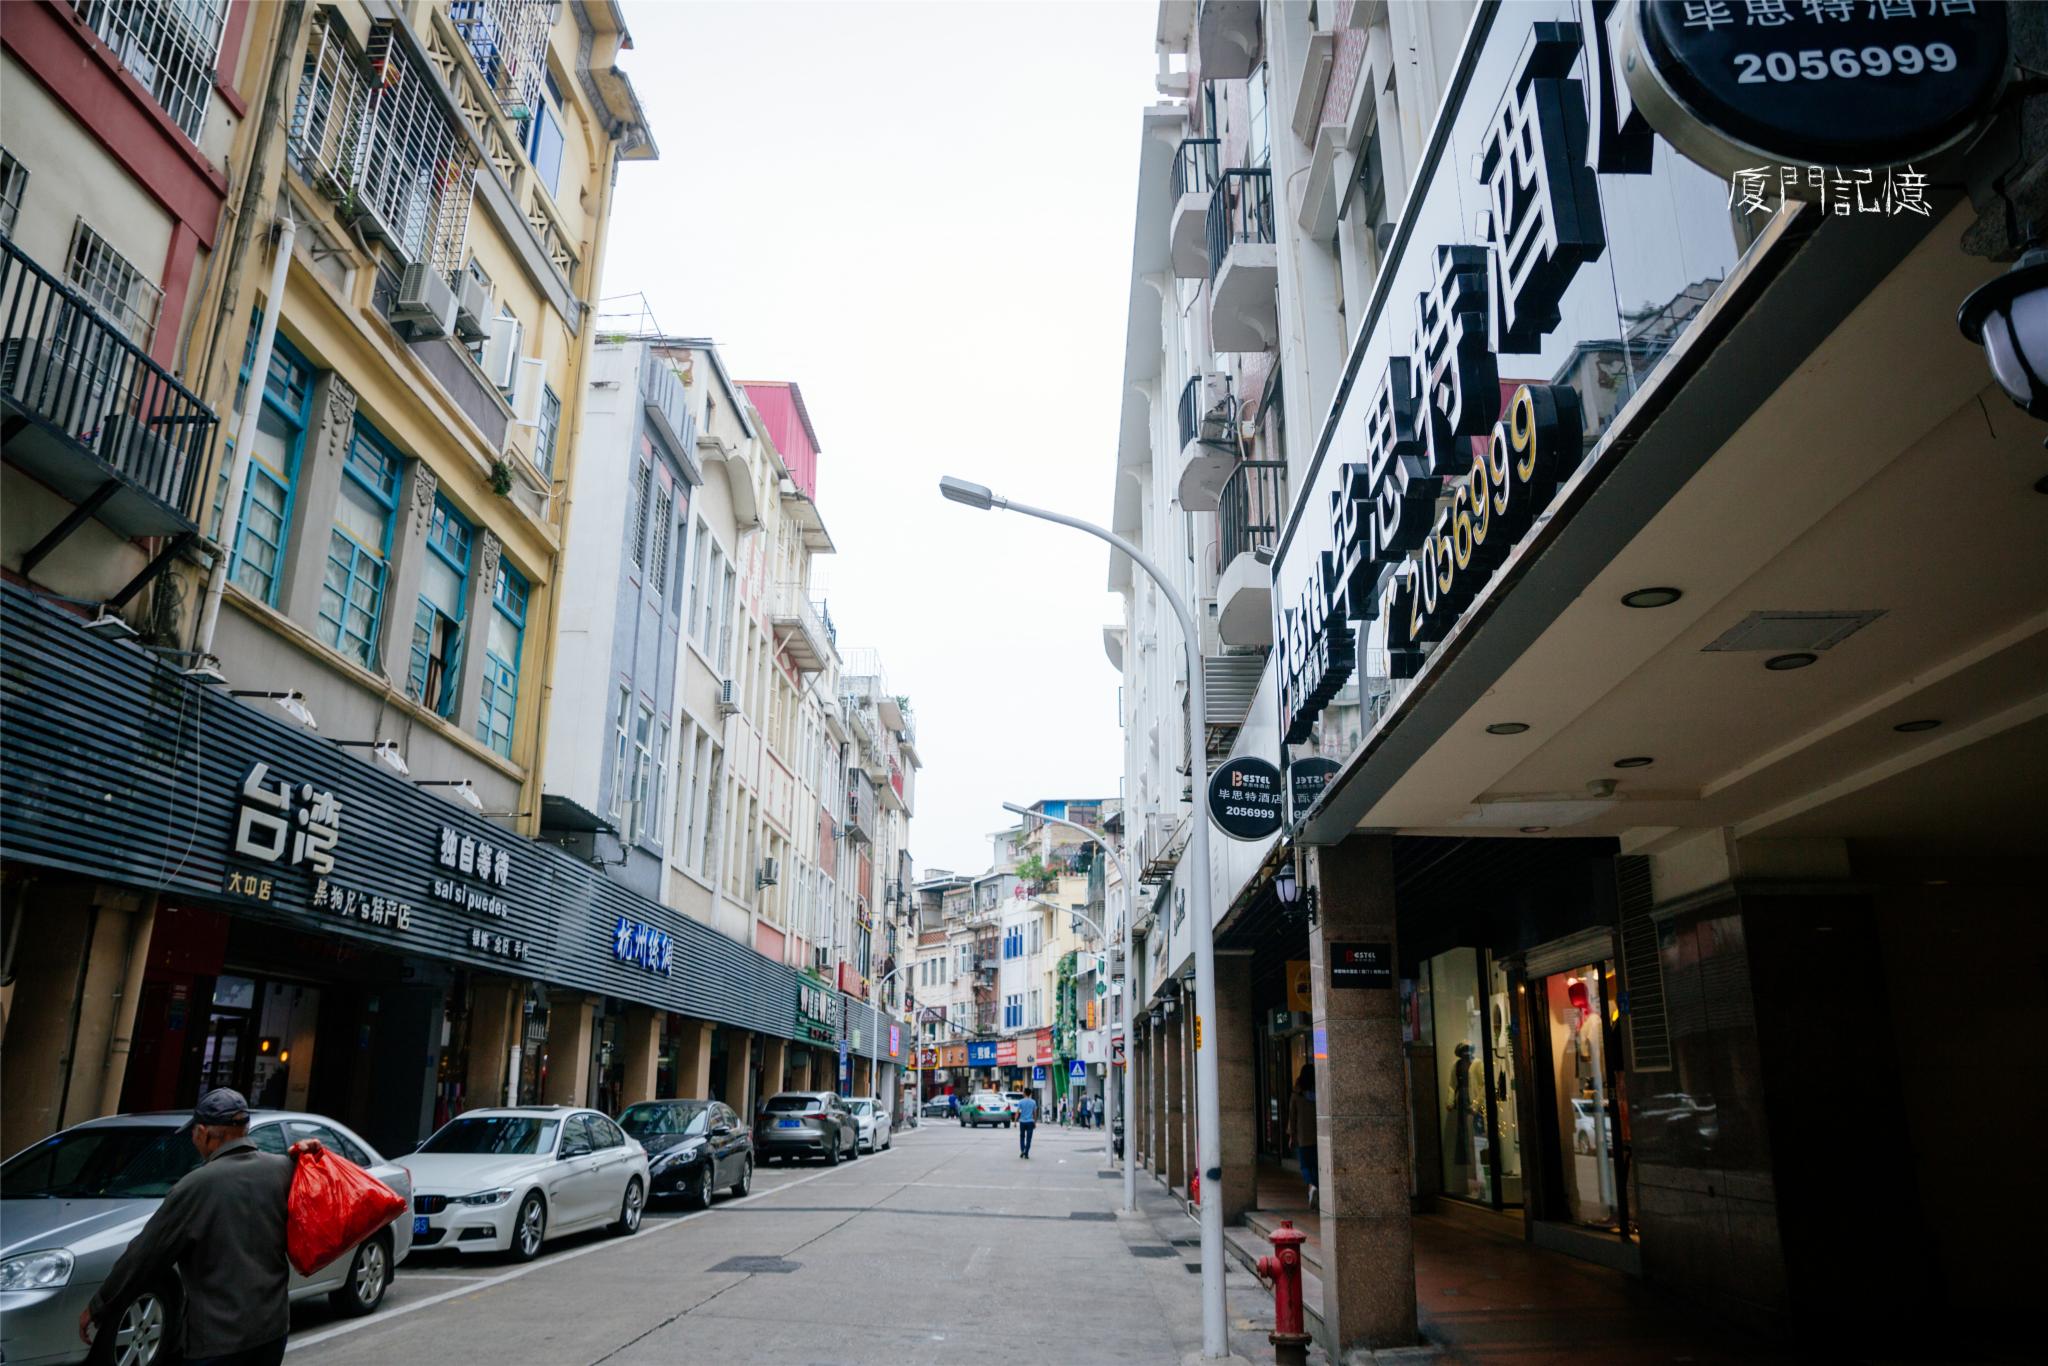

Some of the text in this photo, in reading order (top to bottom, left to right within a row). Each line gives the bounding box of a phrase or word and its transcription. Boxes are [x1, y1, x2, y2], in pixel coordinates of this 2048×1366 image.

[1733, 43, 1957, 84] 2056999
[1407, 383, 1537, 642] 2056999
[1218, 789, 1281, 804] 毕思特酒店
[1232, 770, 1270, 787] BESTEL
[235, 762, 343, 875] 台湾
[1226, 806, 1275, 819] 2056999
[440, 826, 510, 887] 独自等待
[228, 871, 273, 900] 大中店
[434, 880, 507, 918] sal si puedes
